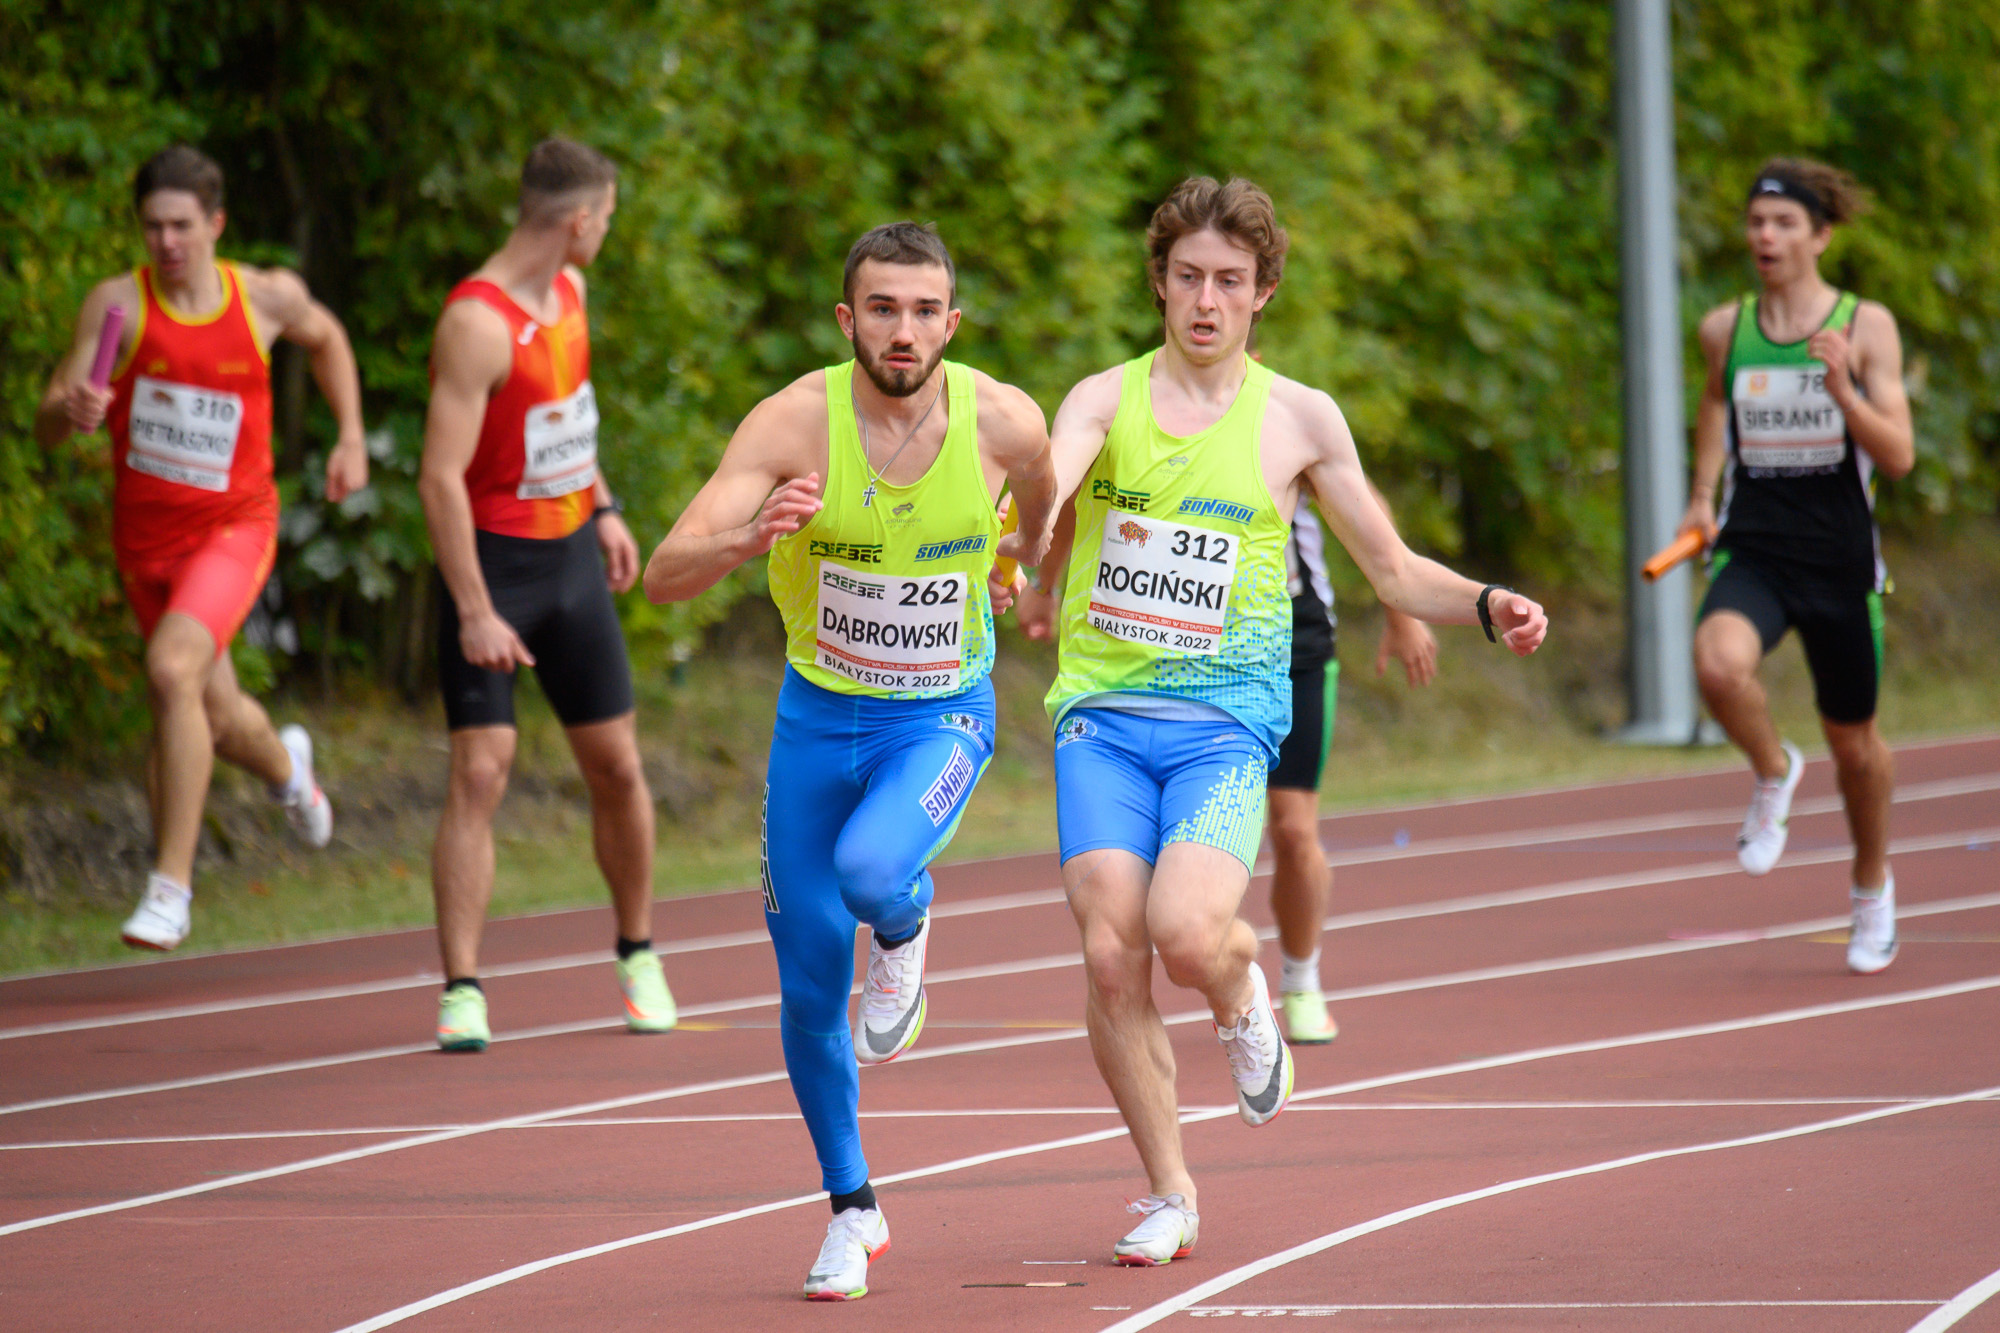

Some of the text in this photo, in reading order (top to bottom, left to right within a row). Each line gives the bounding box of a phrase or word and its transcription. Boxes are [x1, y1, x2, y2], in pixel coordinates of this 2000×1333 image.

[190, 397, 236, 422] 310
[1744, 408, 1833, 430] SIERANT
[1178, 498, 1257, 524] SONAROL
[1170, 530, 1230, 565] 312
[899, 579, 959, 606] 262
[1097, 561, 1225, 610] ROGIŃSKI
[822, 606, 959, 650] DĄBROWSKI
[1094, 616, 1212, 650] BIAŁYSTOK 2022
[1106, 605, 1148, 622] MISTRZOSTWA
[1149, 616, 1172, 626] POLSKI
[1180, 622, 1220, 633] SZTAFETACH
[825, 654, 951, 687] BIAŁYSTOK 2022
[917, 661, 957, 670] SZTAFETACH
